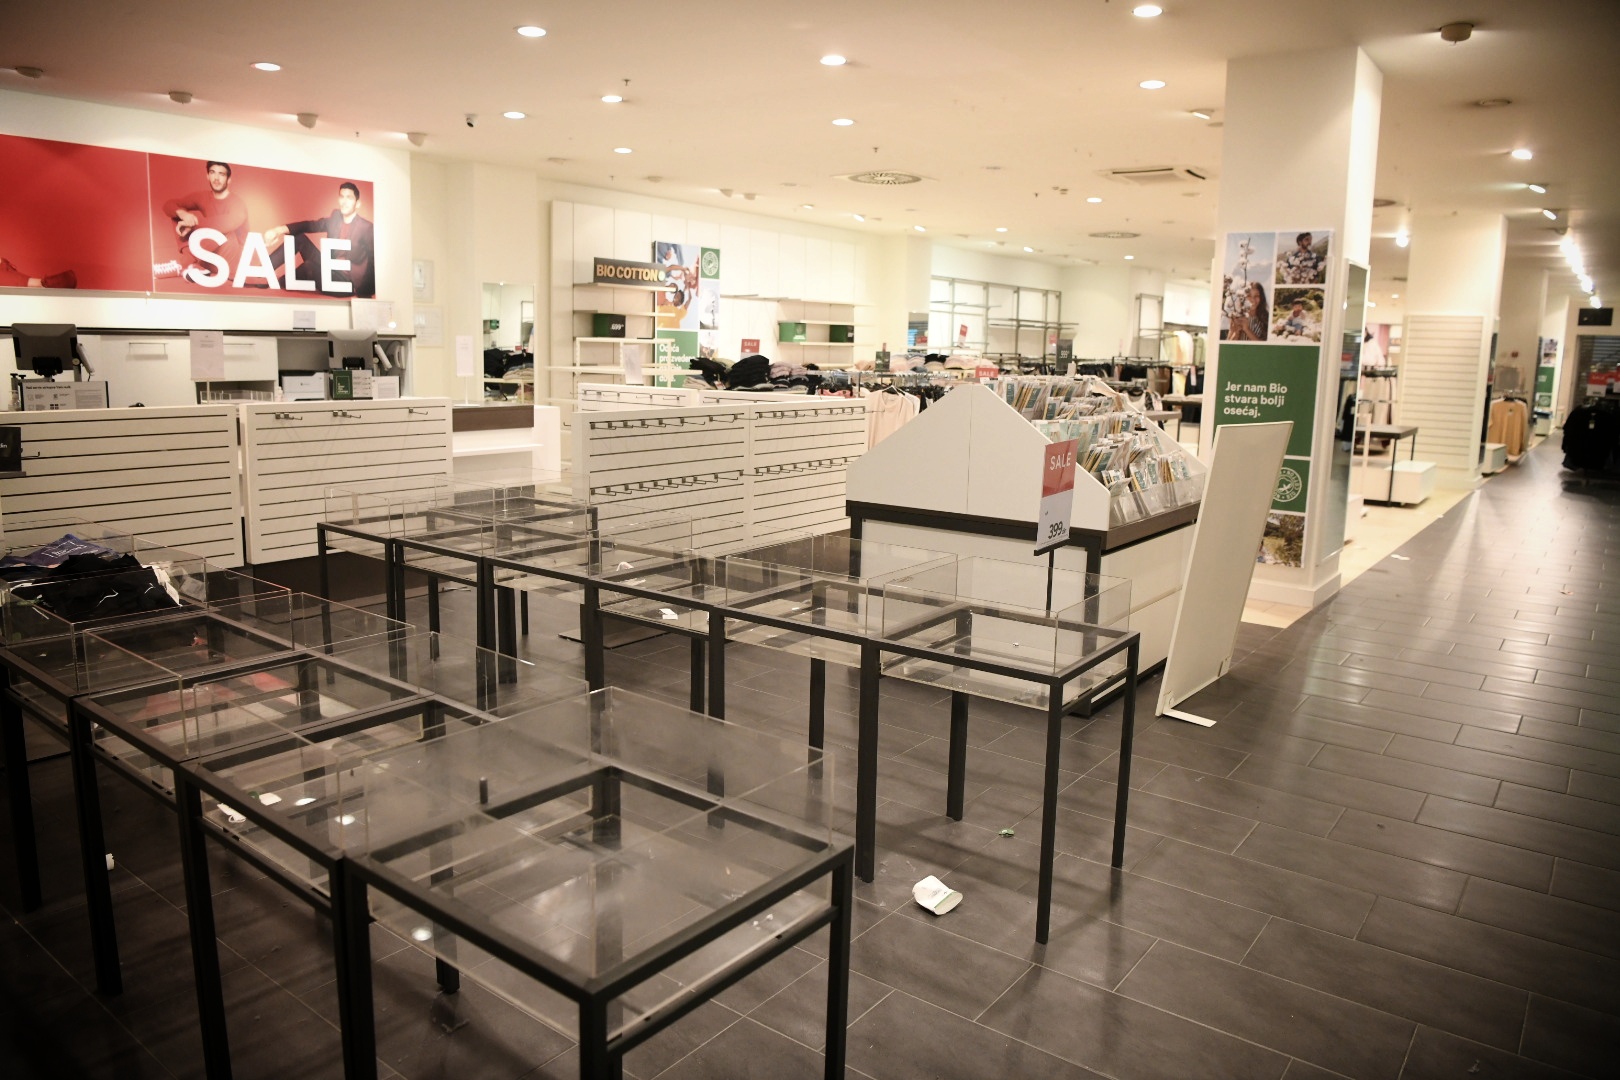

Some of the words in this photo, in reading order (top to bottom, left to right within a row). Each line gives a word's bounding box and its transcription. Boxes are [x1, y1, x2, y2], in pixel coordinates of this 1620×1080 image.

[188, 227, 352, 293] SALE
[596, 265, 615, 277] BIO
[616, 266, 657, 282] COTTON
[1225, 381, 1241, 391] Jer
[1244, 384, 1267, 393] nam
[1269, 383, 1288, 393] Bio
[1224, 394, 1258, 404] stvara
[1260, 394, 1285, 407] bolji
[1223, 406, 1261, 418] osećaj.
[1050, 452, 1072, 471] SALE
[1048, 521, 1063, 539] 399
